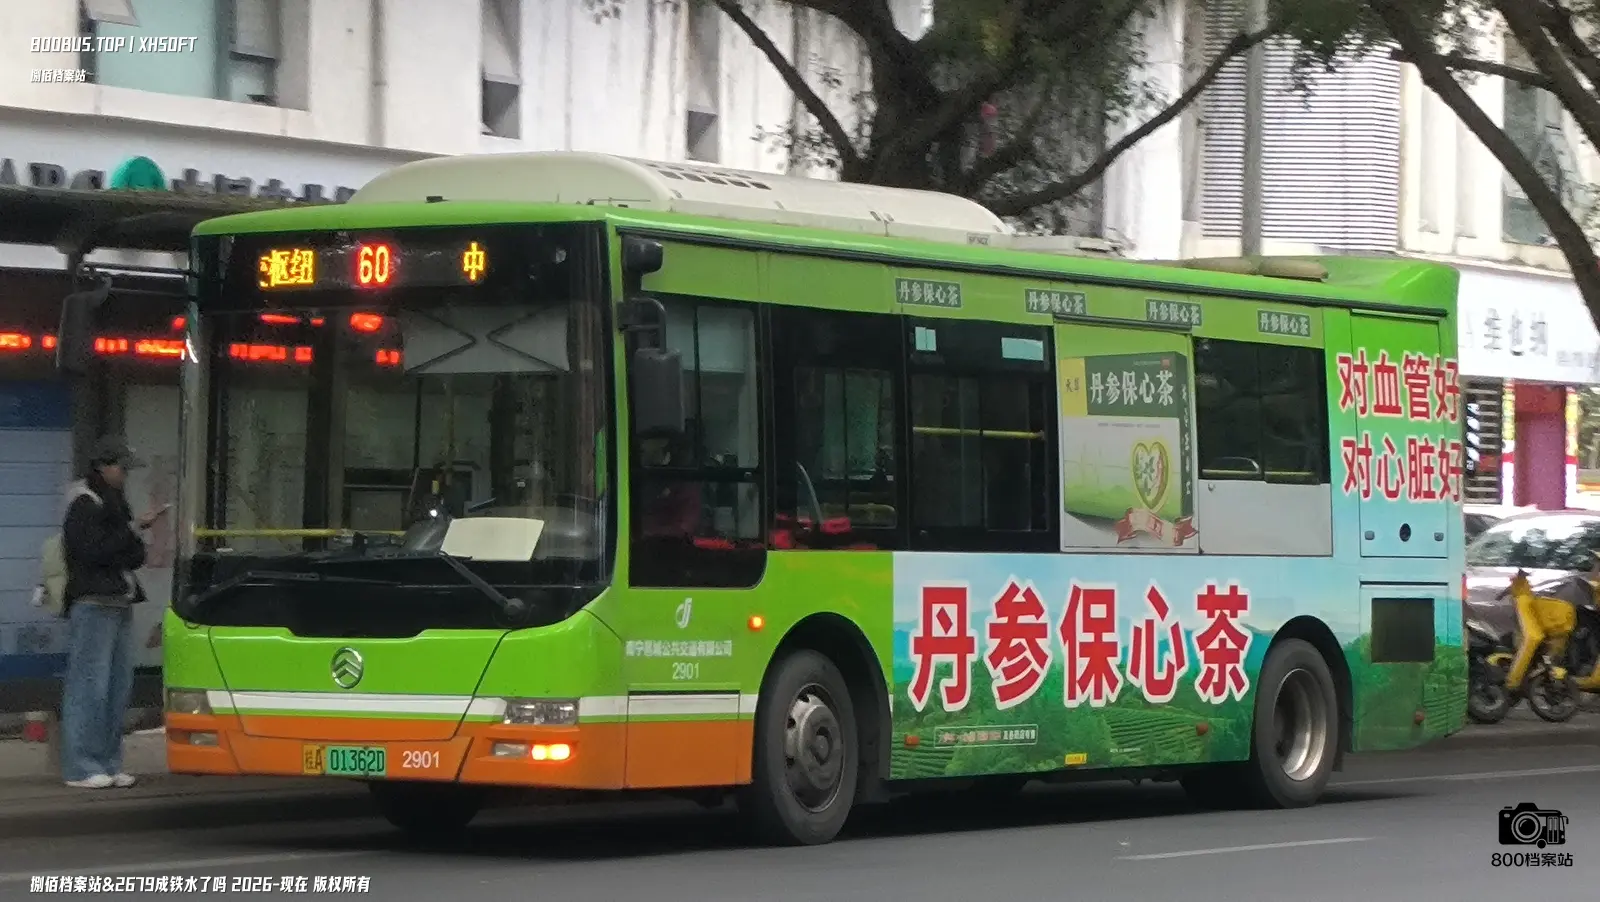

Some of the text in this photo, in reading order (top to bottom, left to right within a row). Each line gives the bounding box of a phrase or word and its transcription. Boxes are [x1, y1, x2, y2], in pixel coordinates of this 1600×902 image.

[359, 246, 389, 284] 60
[463, 242, 485, 281] 中
[899, 280, 959, 305] 丹参保心茶
[1028, 291, 1084, 315] 丹参保心茶
[1149, 301, 1200, 324] 丹参保心茶
[1260, 312, 1309, 336] 丹参保心茶
[1090, 370, 1174, 406] 丹参保心茶
[1337, 349, 1460, 421] 对血管好
[1341, 433, 1464, 502] 对心脏好
[909, 579, 1252, 711] 丹参保心茶
[672, 662, 699, 680] 2901
[402, 750, 440, 768] 2901
